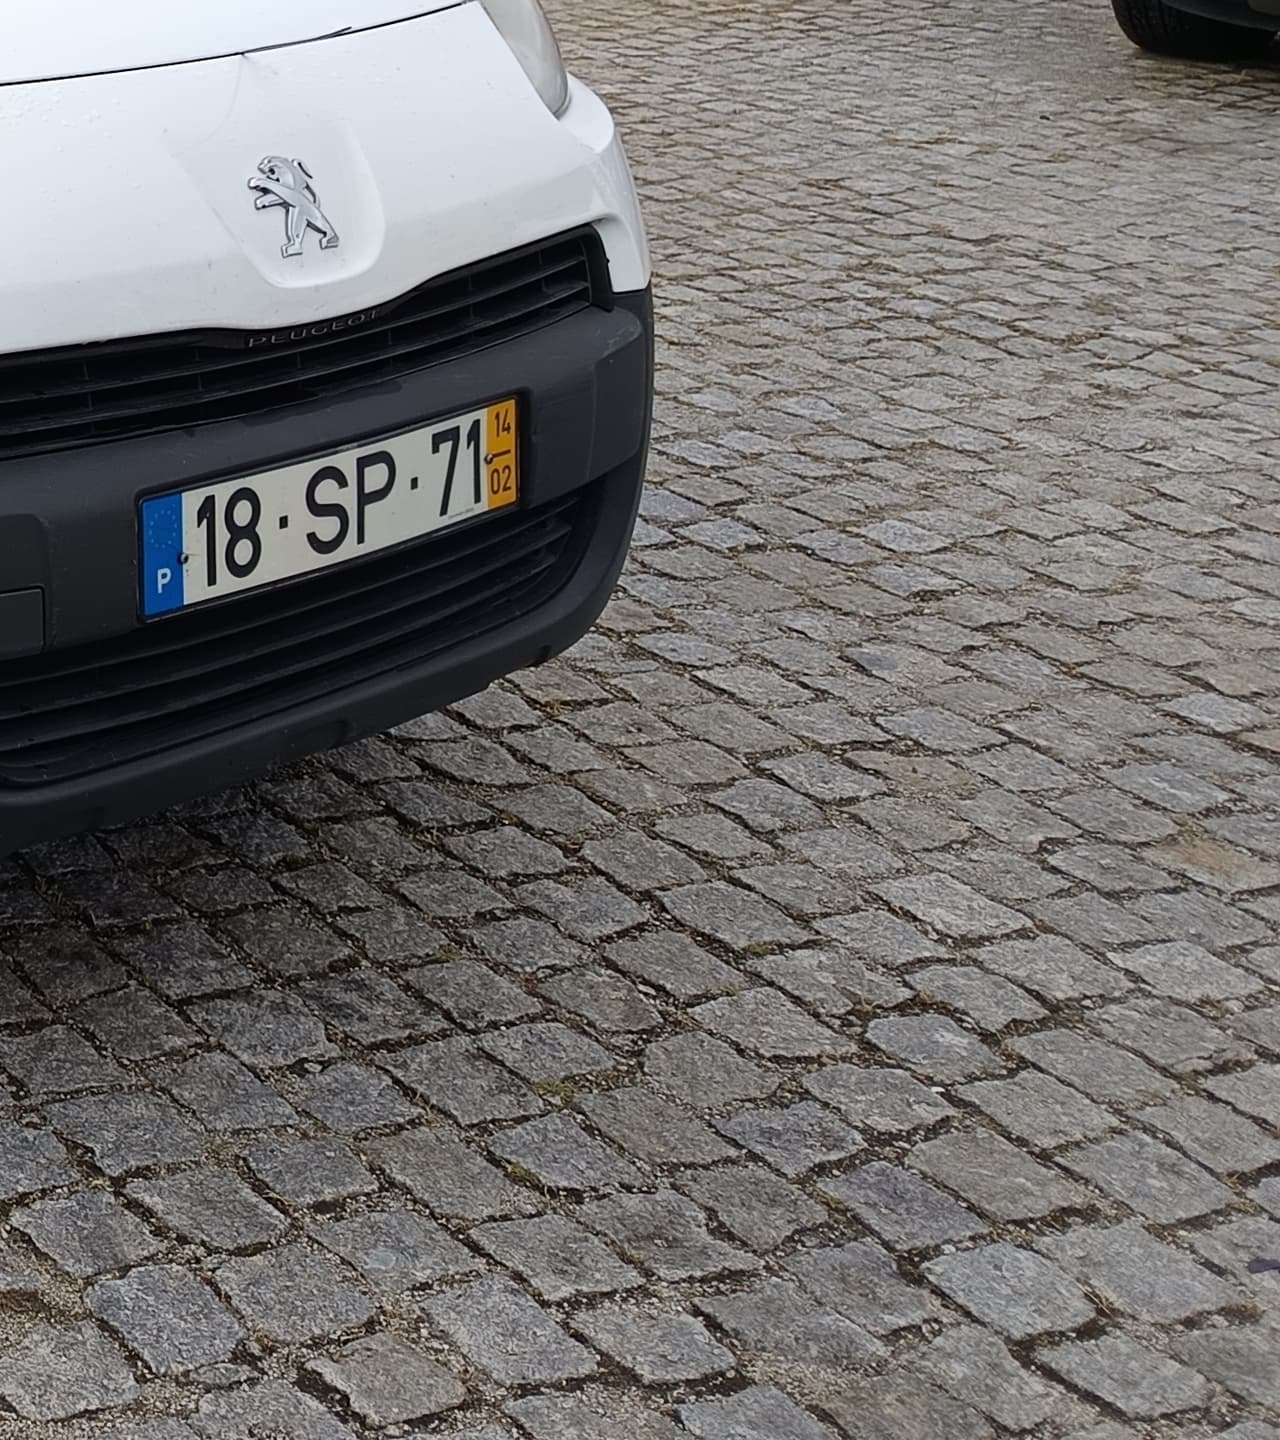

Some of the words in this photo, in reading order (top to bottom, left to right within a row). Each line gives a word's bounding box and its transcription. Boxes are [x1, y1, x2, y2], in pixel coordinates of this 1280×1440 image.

[248, 309, 379, 348] PEUGEOT
[494, 408, 511, 438] 14
[490, 464, 512, 495] 02
[157, 567, 172, 594] P
